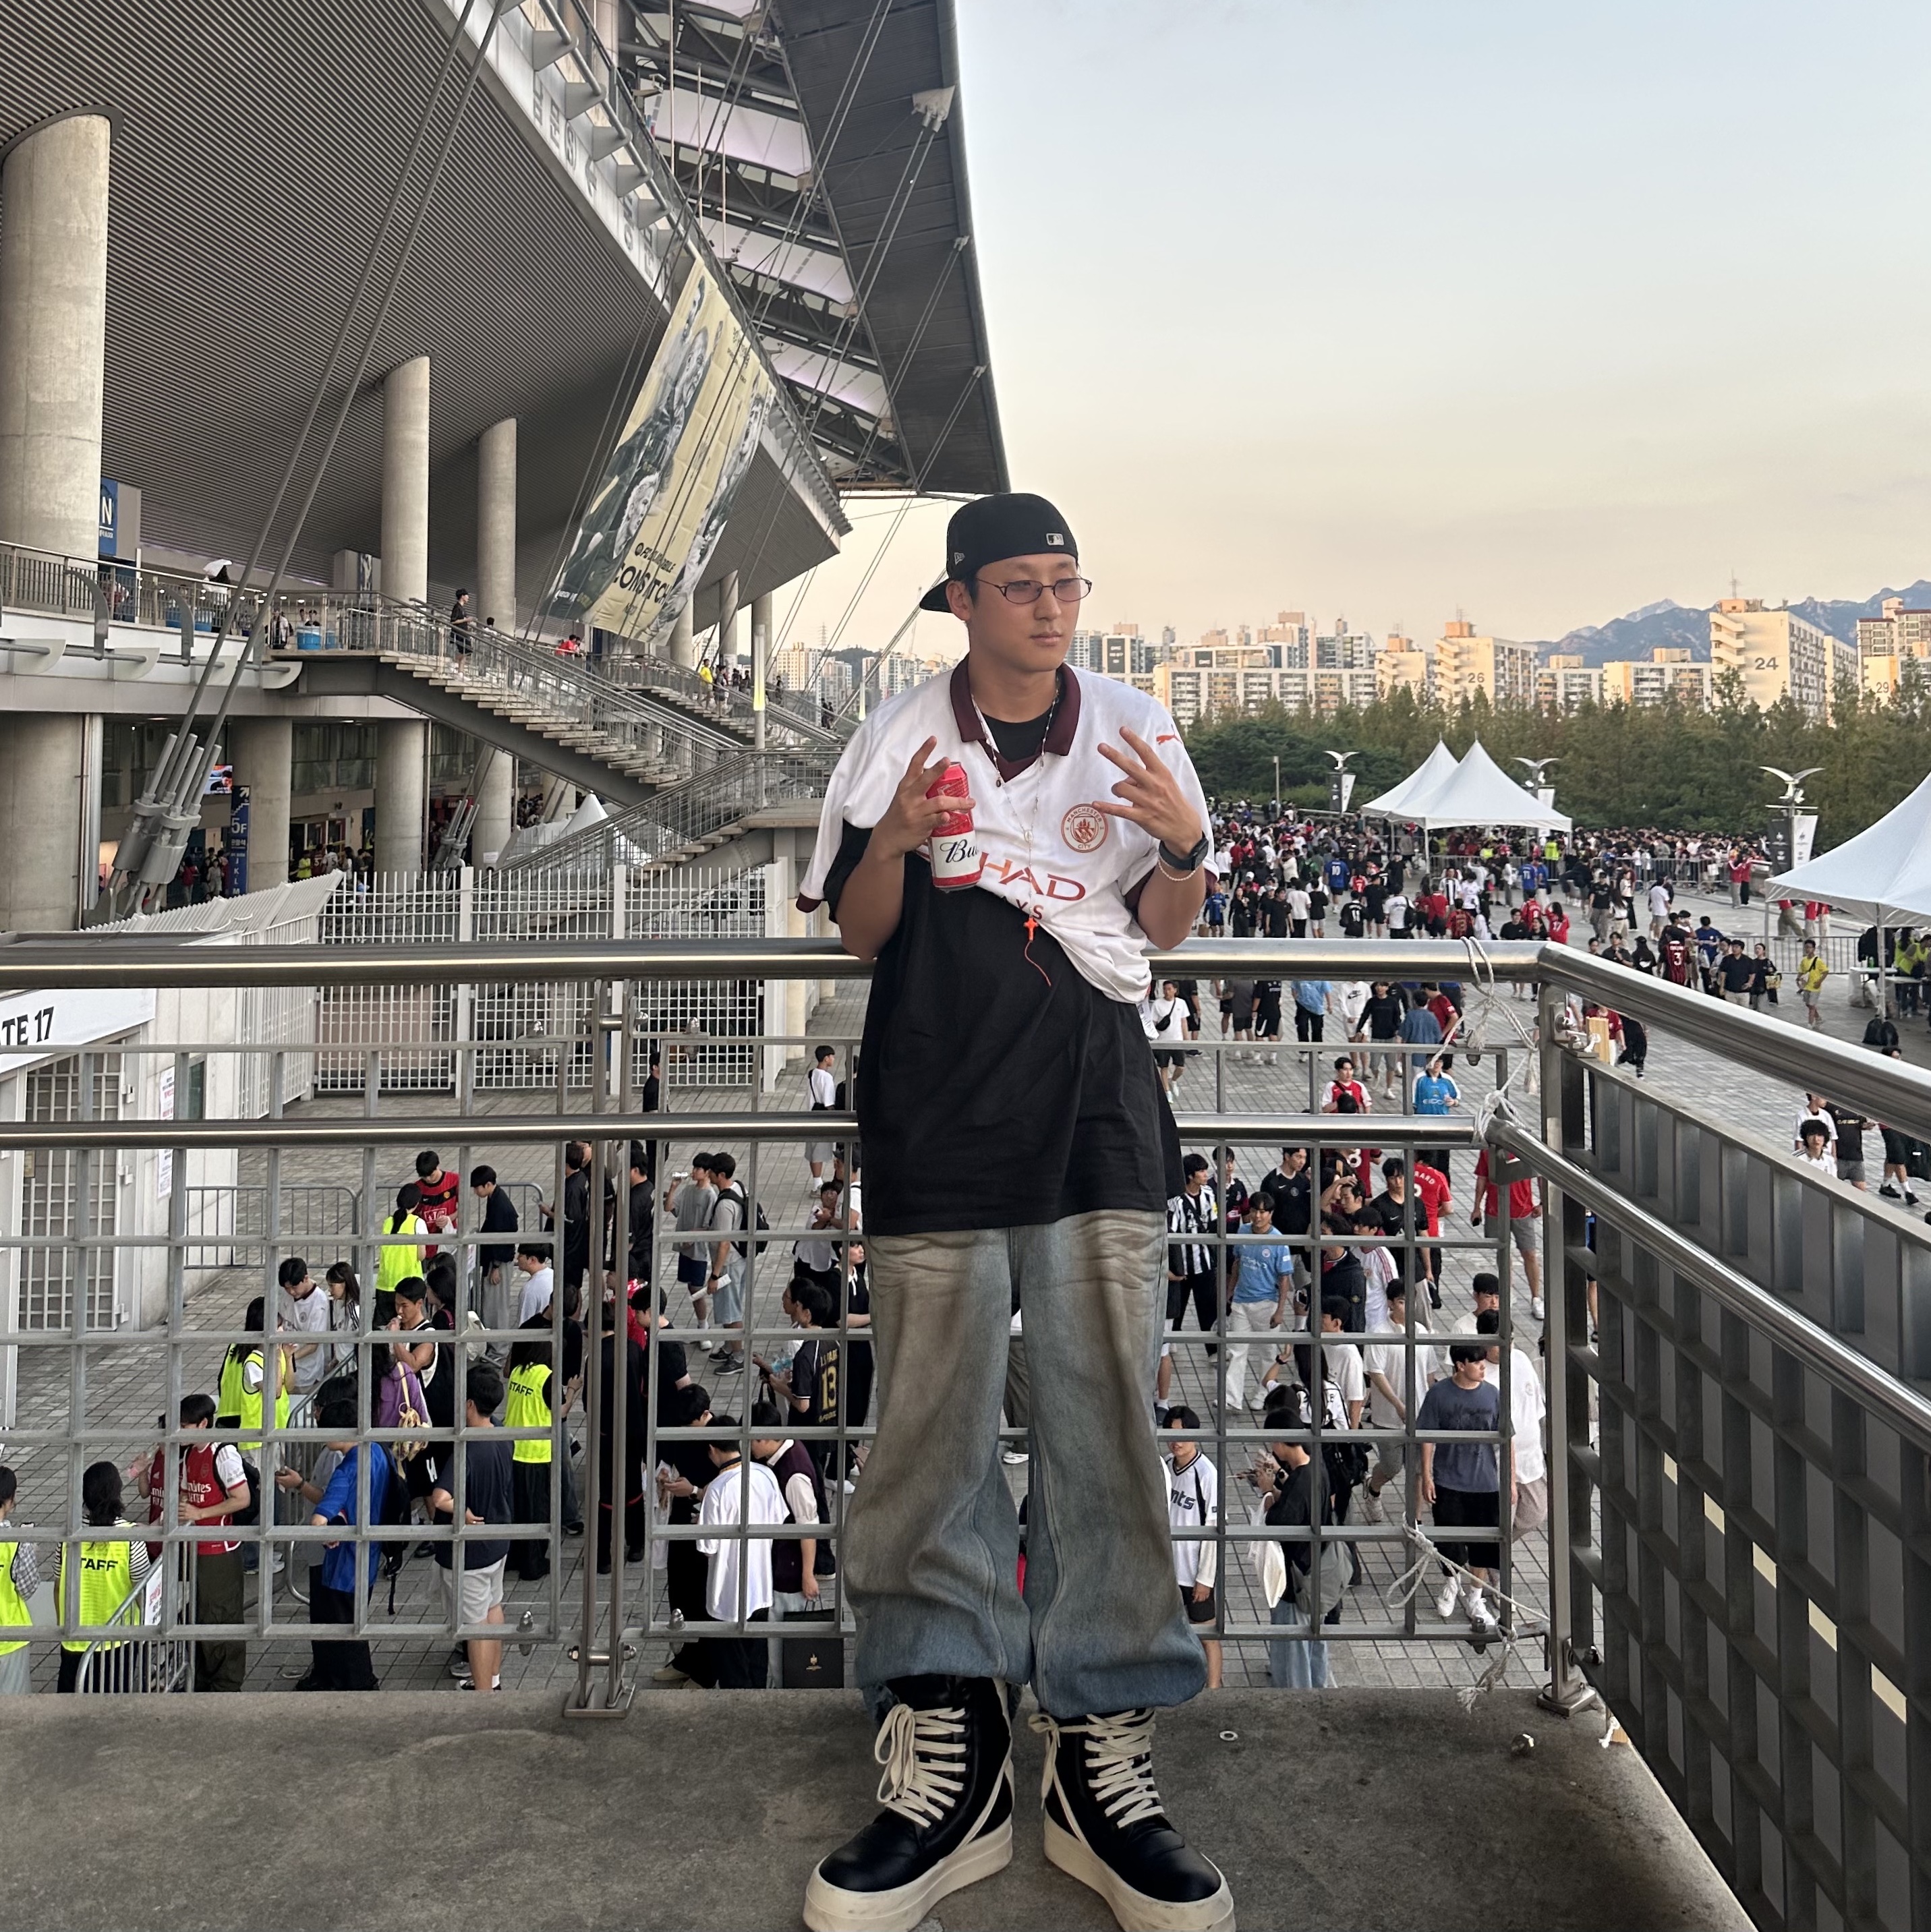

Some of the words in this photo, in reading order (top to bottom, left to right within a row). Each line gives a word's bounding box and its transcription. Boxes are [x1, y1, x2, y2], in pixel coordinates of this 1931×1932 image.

[102, 496, 112, 525] N
[1755, 657, 1779, 670] 24
[1468, 672, 1485, 683] 26
[1876, 682, 1889, 693] 29
[1067, 808, 1102, 823] MANCHESTER
[231, 817, 247, 834] 5F
[979, 852, 1085, 902] HAD
[1673, 952, 1682, 966] 3
[1, 1014, 29, 1045] TE
[34, 1006, 54, 1043] 17
[822, 1366, 836, 1410] 13
[80, 1558, 118, 1572] TAFF
